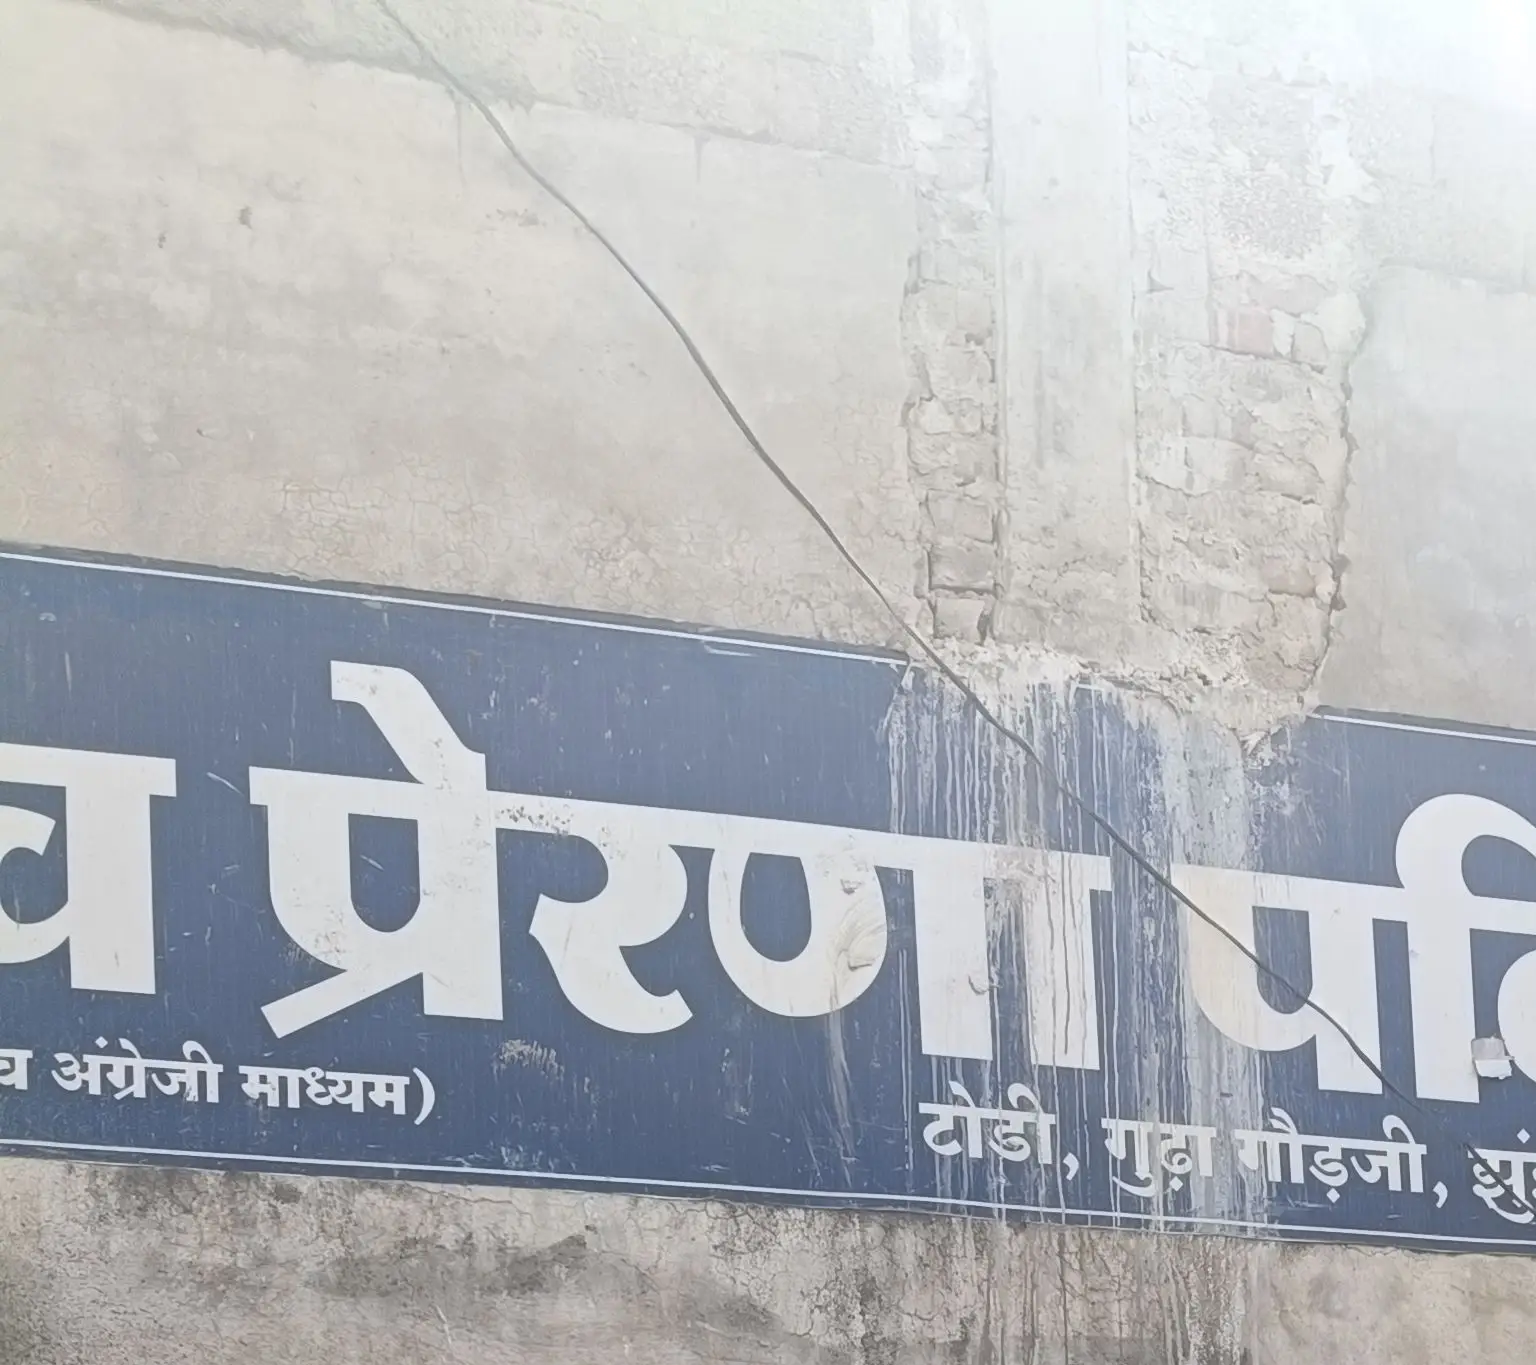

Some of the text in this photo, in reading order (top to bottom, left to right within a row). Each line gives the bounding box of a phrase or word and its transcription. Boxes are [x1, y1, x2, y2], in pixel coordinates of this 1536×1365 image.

[249, 660, 1112, 1070] प्रेरणा
[51, 1036, 224, 1104] अंग्रेजी
[239, 1065, 436, 1126] माध्यम)
[918, 1080, 1080, 1181] टोडी,
[1234, 1106, 1449, 1210] गौड़जी,
